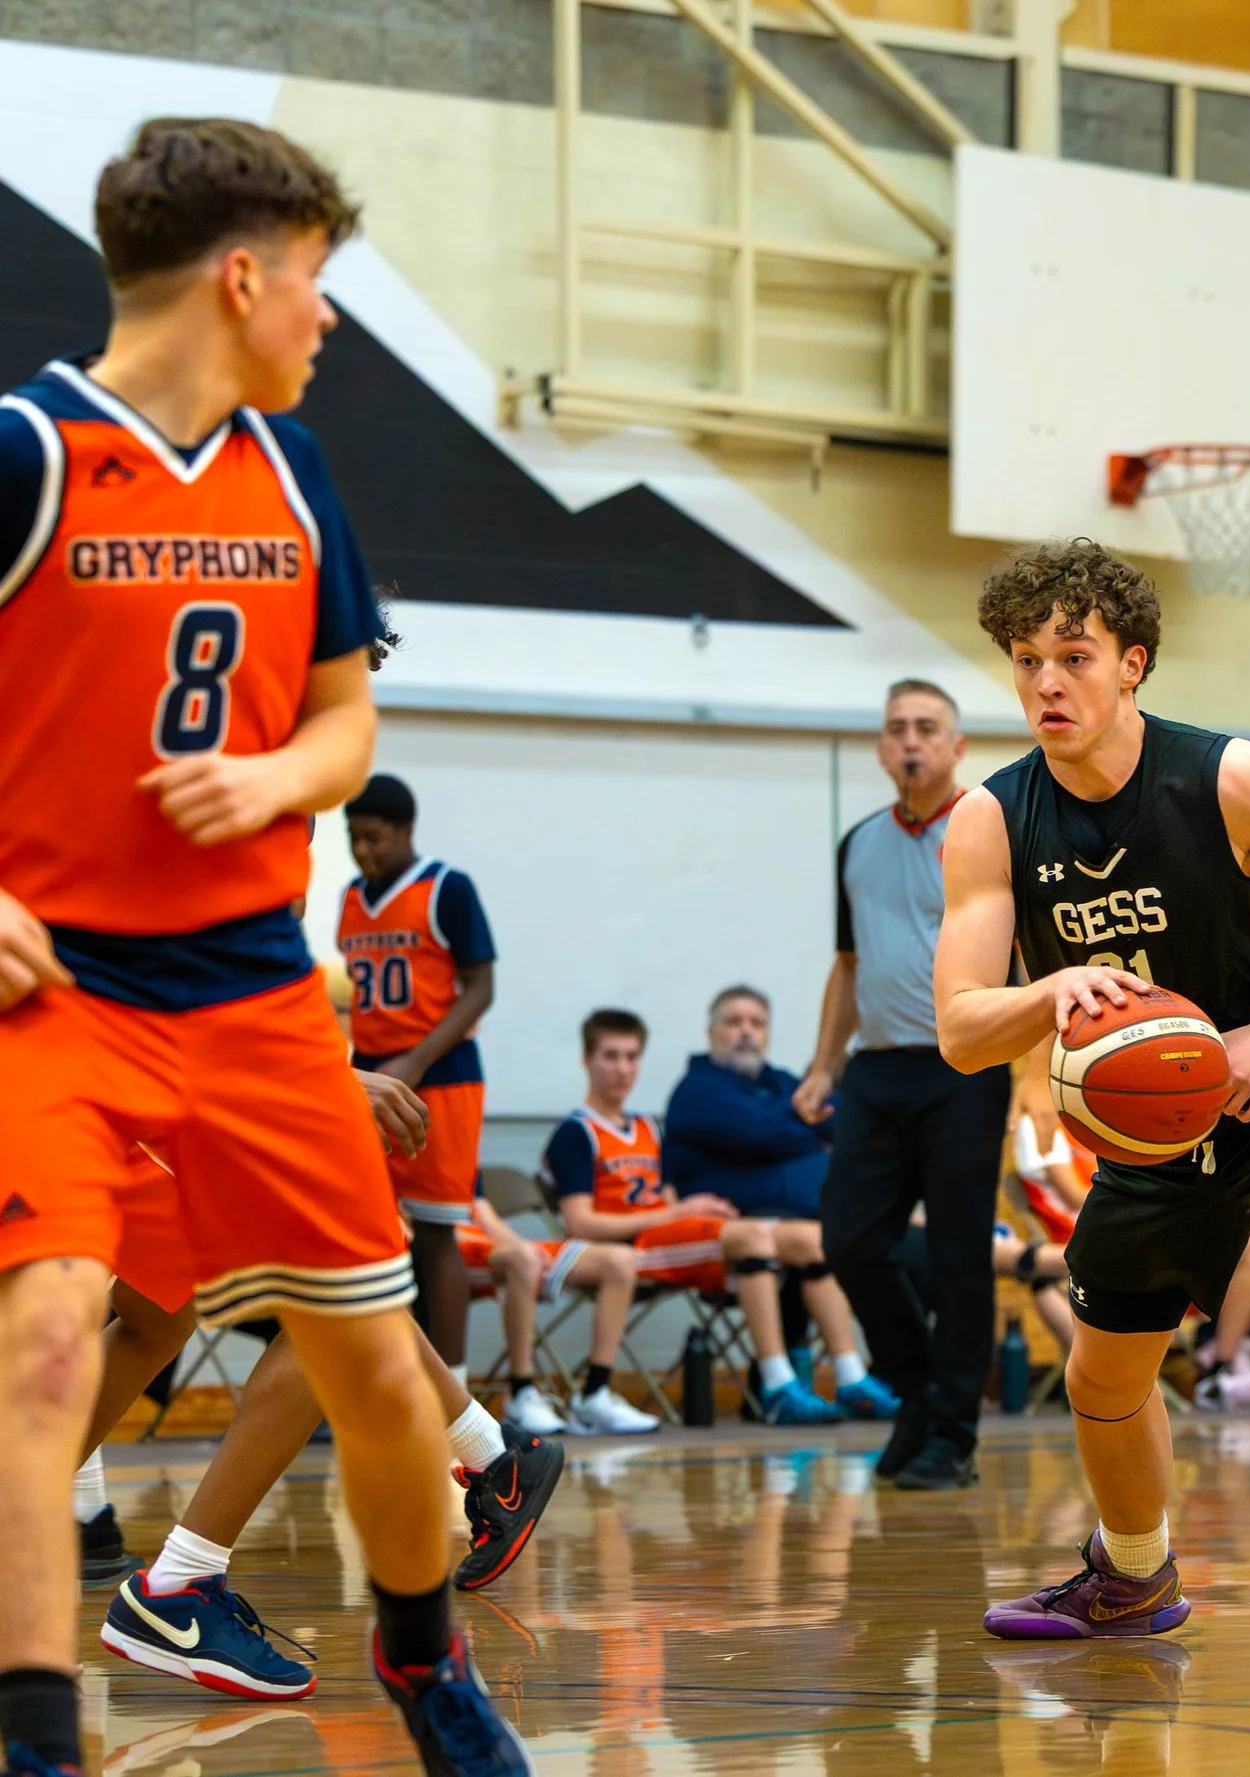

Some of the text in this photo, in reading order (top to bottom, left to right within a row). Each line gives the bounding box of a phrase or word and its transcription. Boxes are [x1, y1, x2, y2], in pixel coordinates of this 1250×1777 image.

[70, 536, 303, 584] GRYPHONS
[152, 600, 246, 762] 8
[1052, 887, 1168, 945] GESS
[1086, 949, 1155, 986] 1
